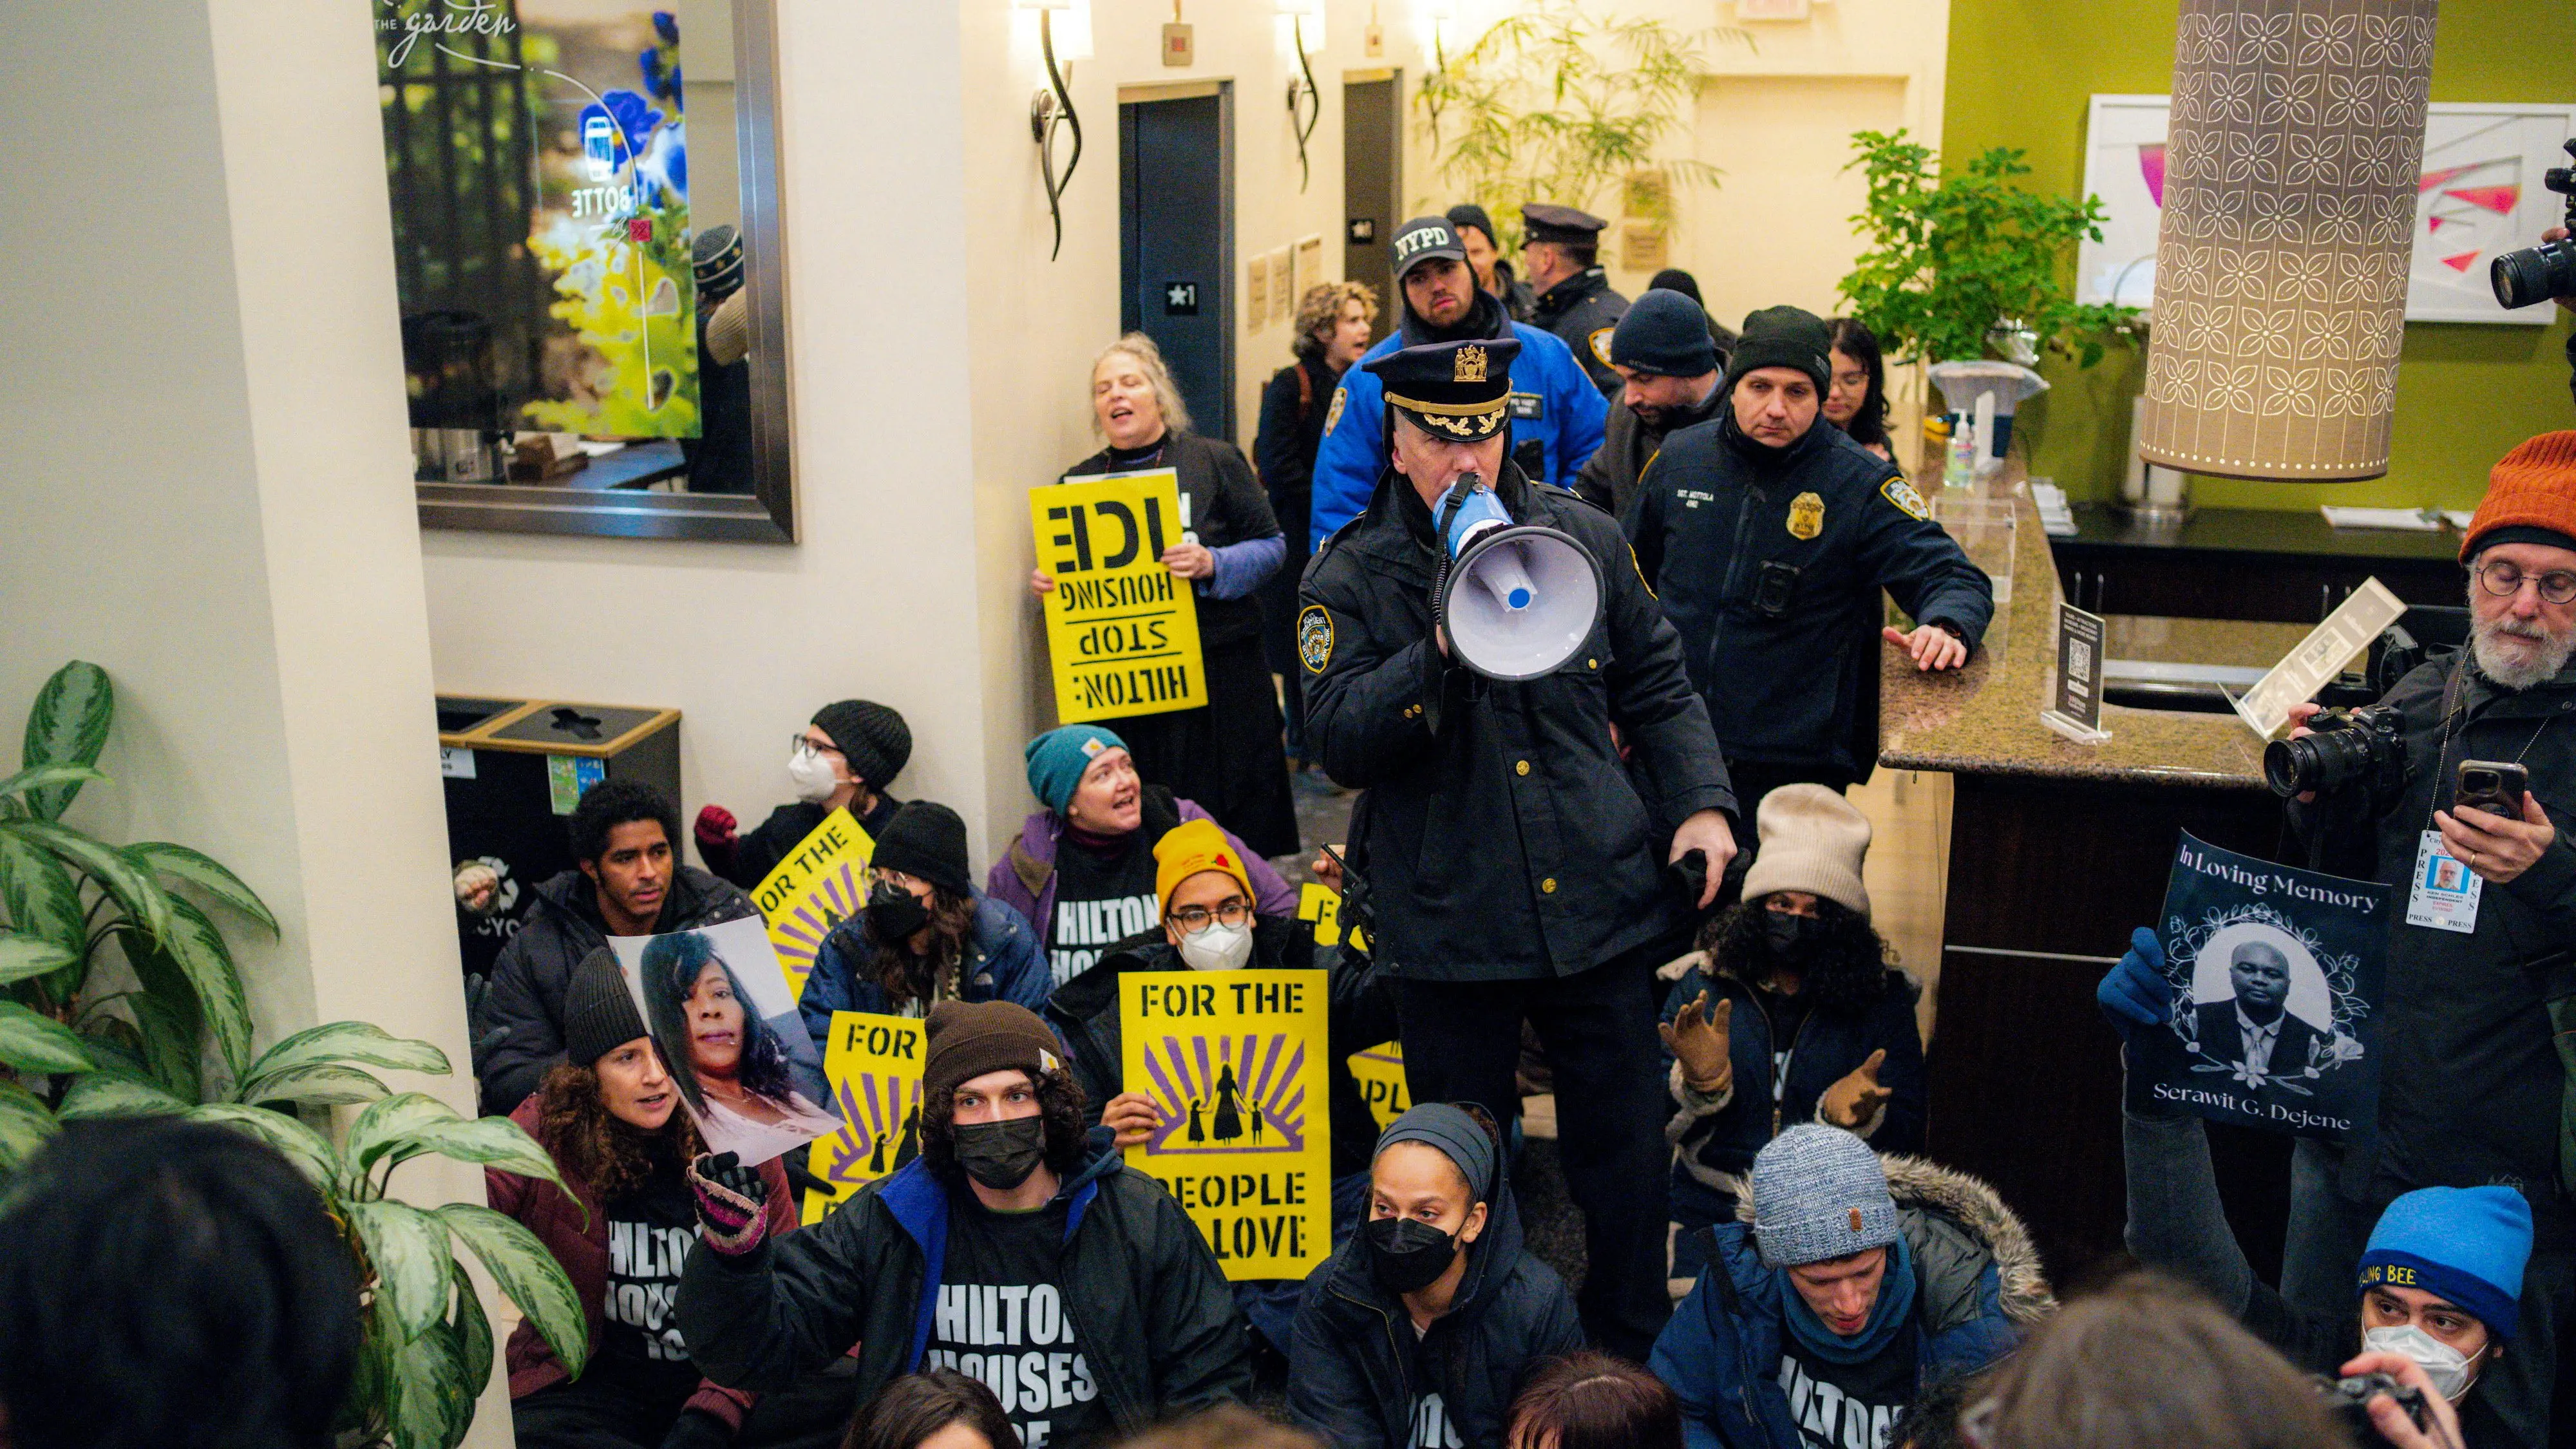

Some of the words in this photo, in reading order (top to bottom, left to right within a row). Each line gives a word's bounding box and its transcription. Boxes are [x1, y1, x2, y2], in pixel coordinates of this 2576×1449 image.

[375, 19, 397, 30] THE
[388, 0, 516, 69] garden
[1394, 227, 1450, 261] NYPD
[1048, 497, 1166, 574] ICE
[1059, 571, 1174, 612] HOUSING
[1079, 620, 1169, 655] STOP
[1073, 665, 1189, 708] HILTON:
[761, 875, 796, 912] OR
[794, 826, 848, 875] THE
[2179, 844, 2193, 867] In
[2195, 852, 2269, 895] Loving
[2273, 875, 2380, 913] Memory
[2412, 849, 2427, 903] PRESS
[2427, 895, 2463, 904] INDEPENDENT
[2468, 873, 2479, 911] ESS
[2409, 914, 2432, 922] PRESS
[2448, 920, 2472, 929] PRESS
[1142, 984, 1216, 1017] FOR
[1229, 983, 1303, 1014] THE
[846, 1023, 917, 1059] FOR
[2154, 1083, 2236, 1110] Serawit
[2242, 1099, 2264, 1116] G.
[2271, 1103, 2351, 1130] Dejene
[1155, 1172, 1305, 1209] EOPLE
[609, 1220, 703, 1278] HILTO
[1213, 1215, 1306, 1260] LOVE
[2387, 1264, 2417, 1285] BEE
